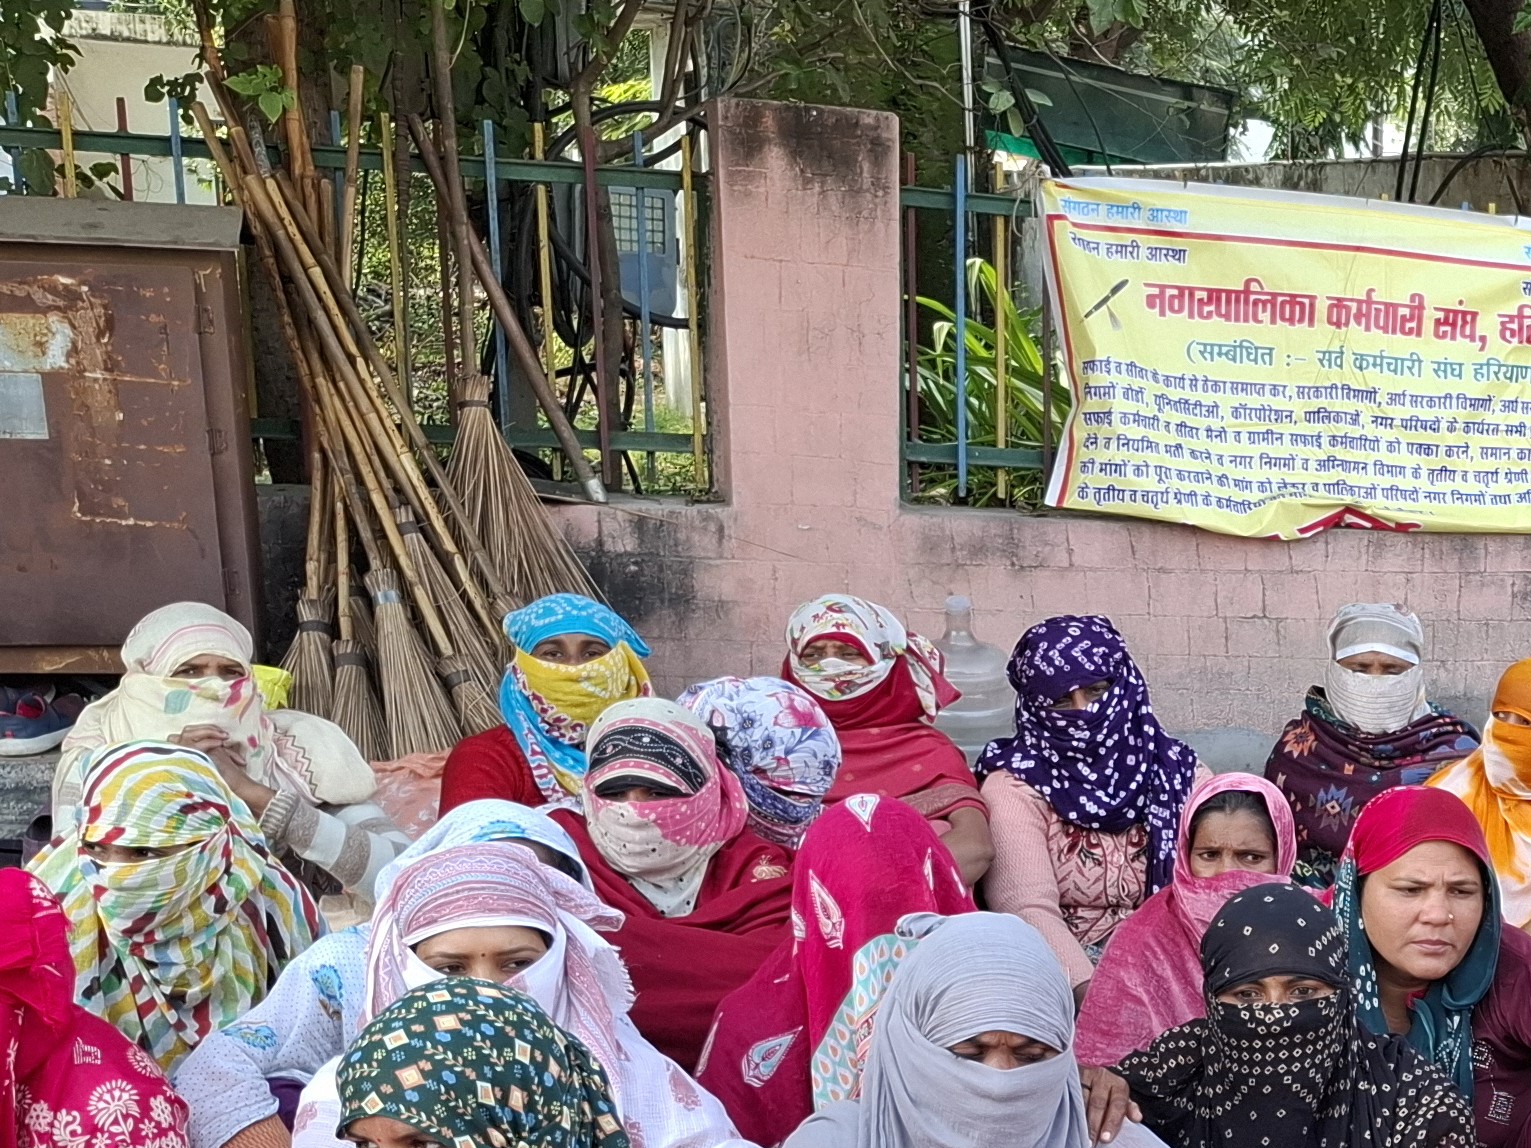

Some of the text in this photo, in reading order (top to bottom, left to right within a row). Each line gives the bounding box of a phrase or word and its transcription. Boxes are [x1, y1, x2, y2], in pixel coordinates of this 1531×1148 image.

[1060, 197, 1188, 224] संगठन हमारी आस्था
[1105, 240, 1141, 261] हमारी
[1146, 246, 1187, 264] आस्था
[1143, 277, 1318, 328] नगरपालिका
[1326, 288, 1426, 338] कर्मचारी
[1433, 299, 1489, 352] संघ,
[1315, 345, 1345, 370] सर्व
[1352, 350, 1423, 378] कर्मचारी
[1431, 357, 1464, 380] संघ
[1295, 383, 1339, 400] सरकारी
[1409, 393, 1453, 410] सरकारी
[1082, 407, 1113, 427] सफाई
[1119, 410, 1160, 432] कर्मचारी
[1289, 431, 1322, 449] सफाई
[1385, 436, 1401, 454] को
[1479, 446, 1512, 460] समान
[1370, 415, 1396, 430] नगर
[1446, 416, 1459, 434] के
[1228, 455, 1254, 469] नगर
[1259, 452, 1298, 471] निगमों
[1411, 463, 1422, 479] के
[1077, 482, 1090, 500] के
[1093, 484, 1127, 506] तृतीय
[1200, 491, 1213, 507] के
[1132, 461, 1151, 479] को
[1256, 478, 1273, 494] को
[1422, 491, 1447, 504] नगर
